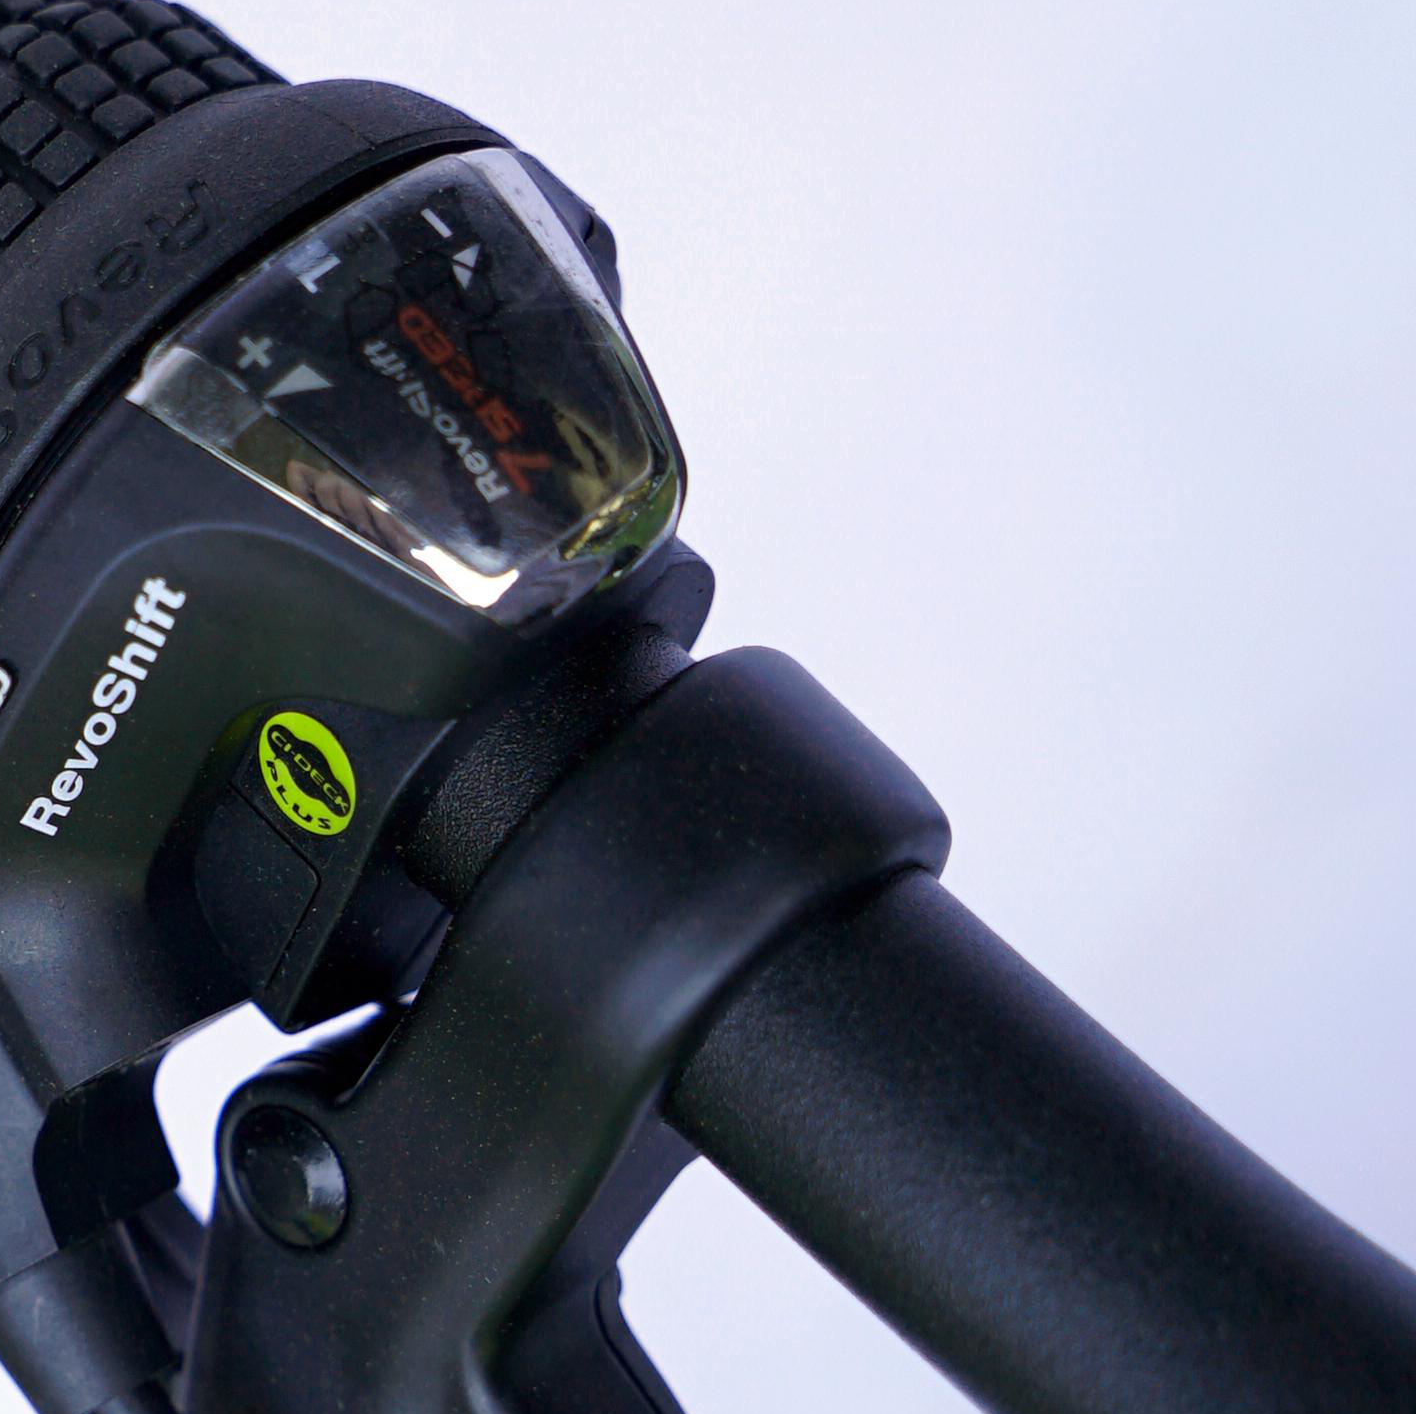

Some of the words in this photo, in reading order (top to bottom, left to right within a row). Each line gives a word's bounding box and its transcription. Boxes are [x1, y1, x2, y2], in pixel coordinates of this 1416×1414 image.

[495, 449, 552, 494] 7
[19, 576, 187, 838] RevoShift
[266, 759, 332, 830] PLUS
[270, 730, 350, 814] CI-DECK
